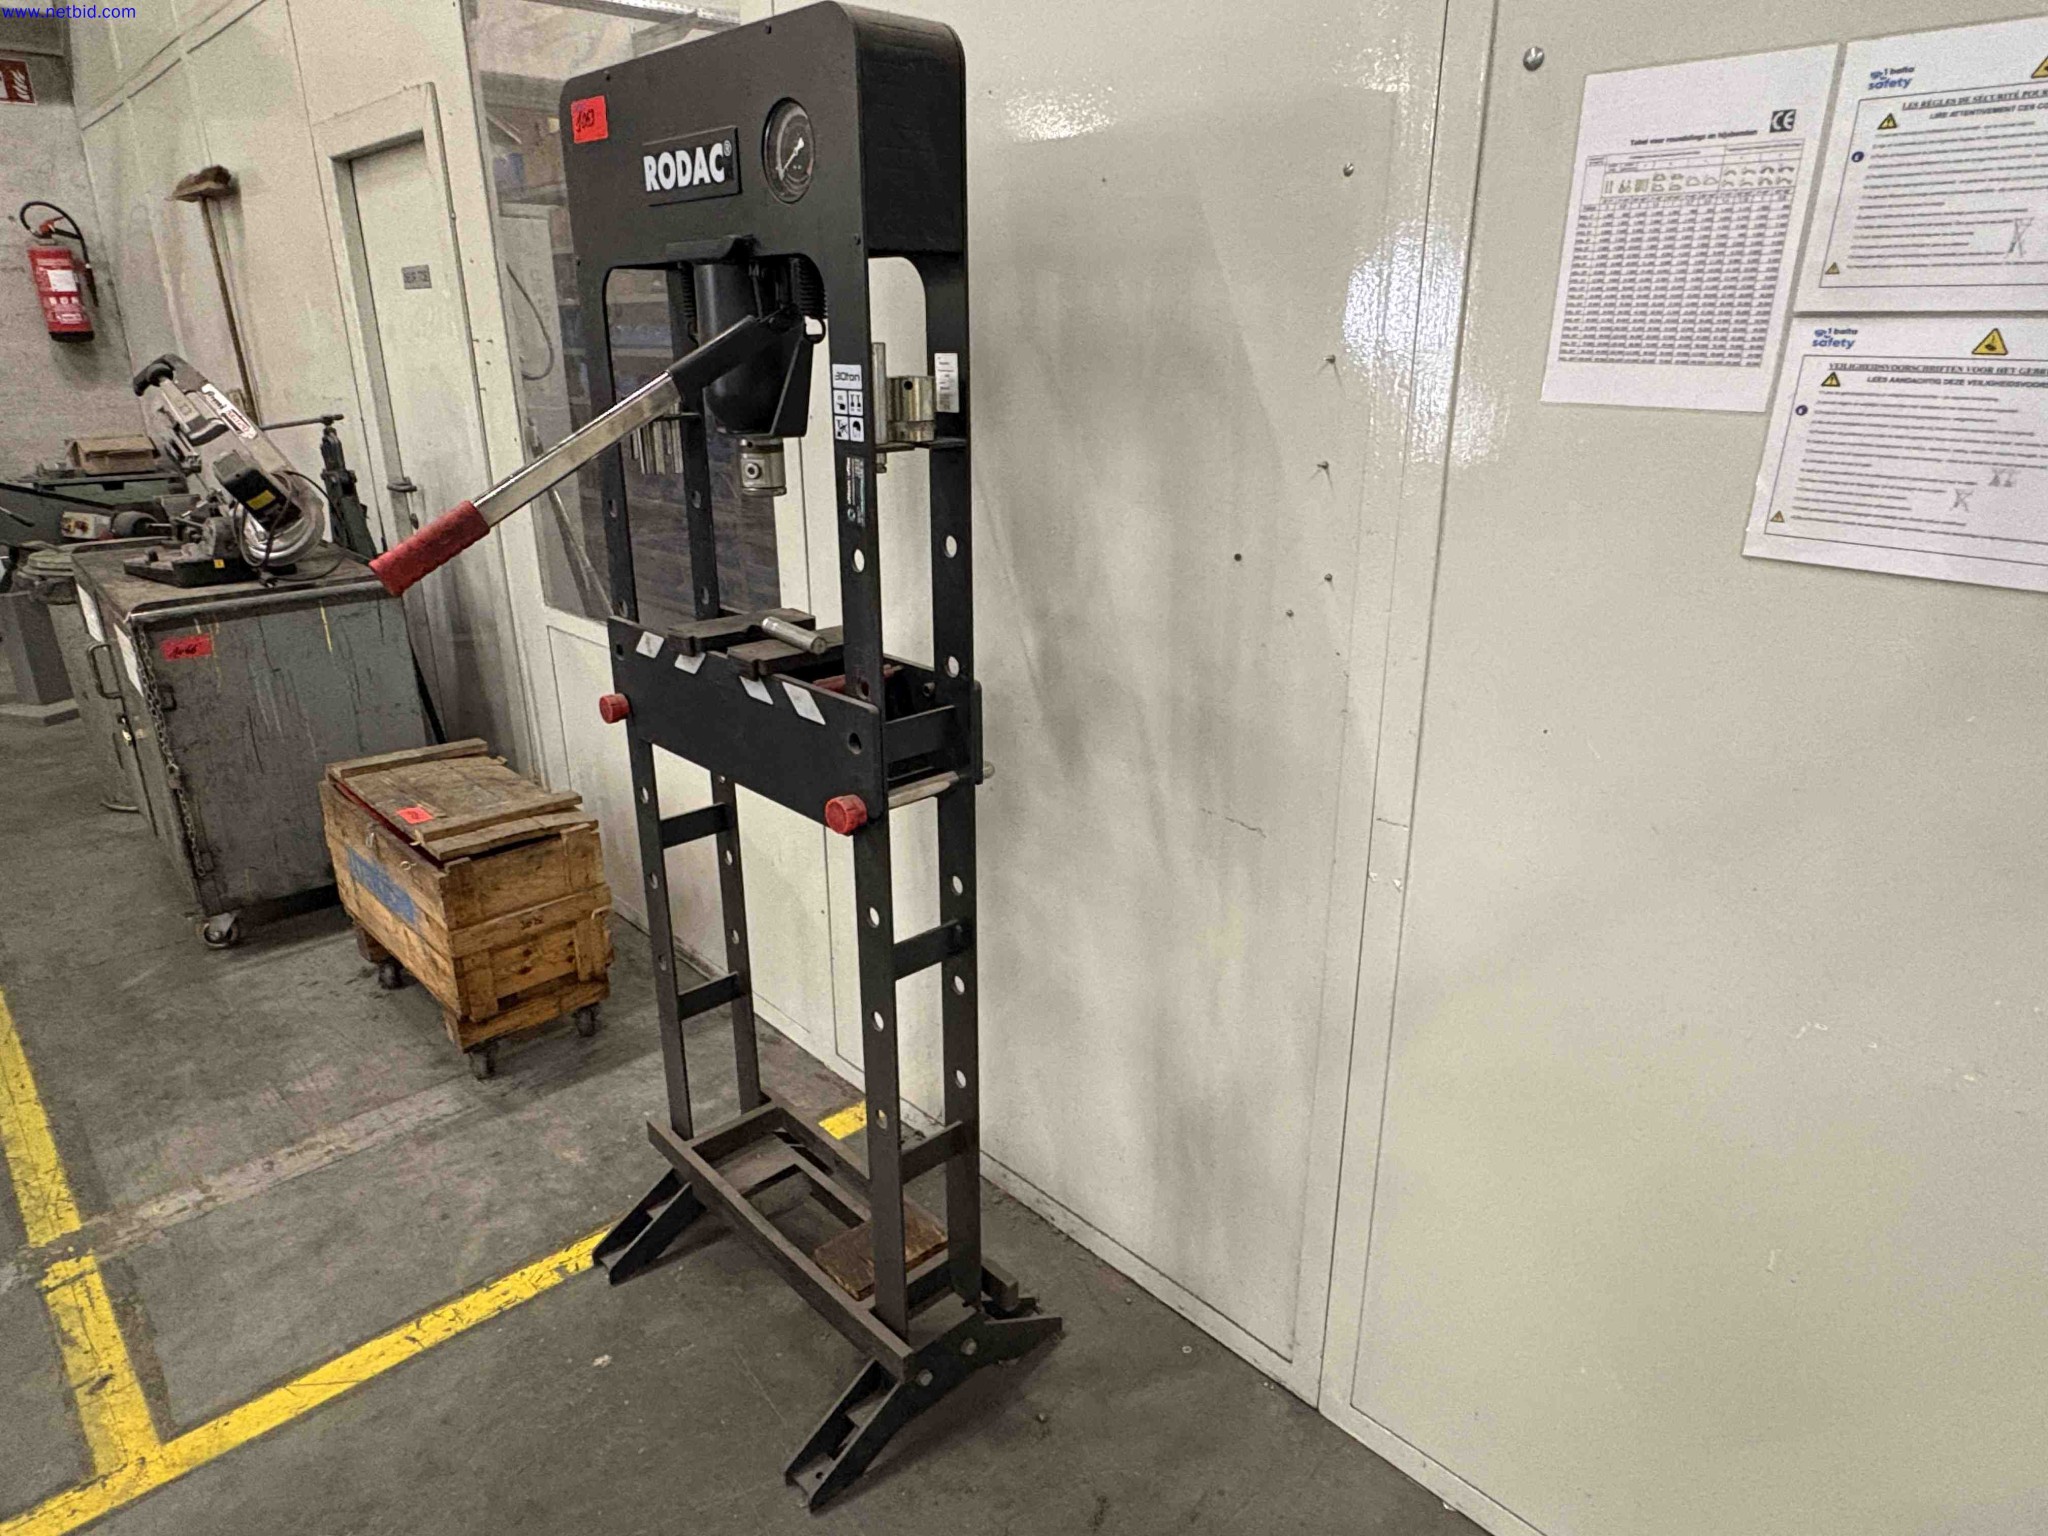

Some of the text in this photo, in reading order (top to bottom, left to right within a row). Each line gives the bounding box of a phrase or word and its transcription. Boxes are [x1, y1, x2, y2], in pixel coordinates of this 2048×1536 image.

[1868, 78, 1913, 90] safety
[1773, 110, 1794, 131] CE
[1812, 338, 1855, 350] safety
